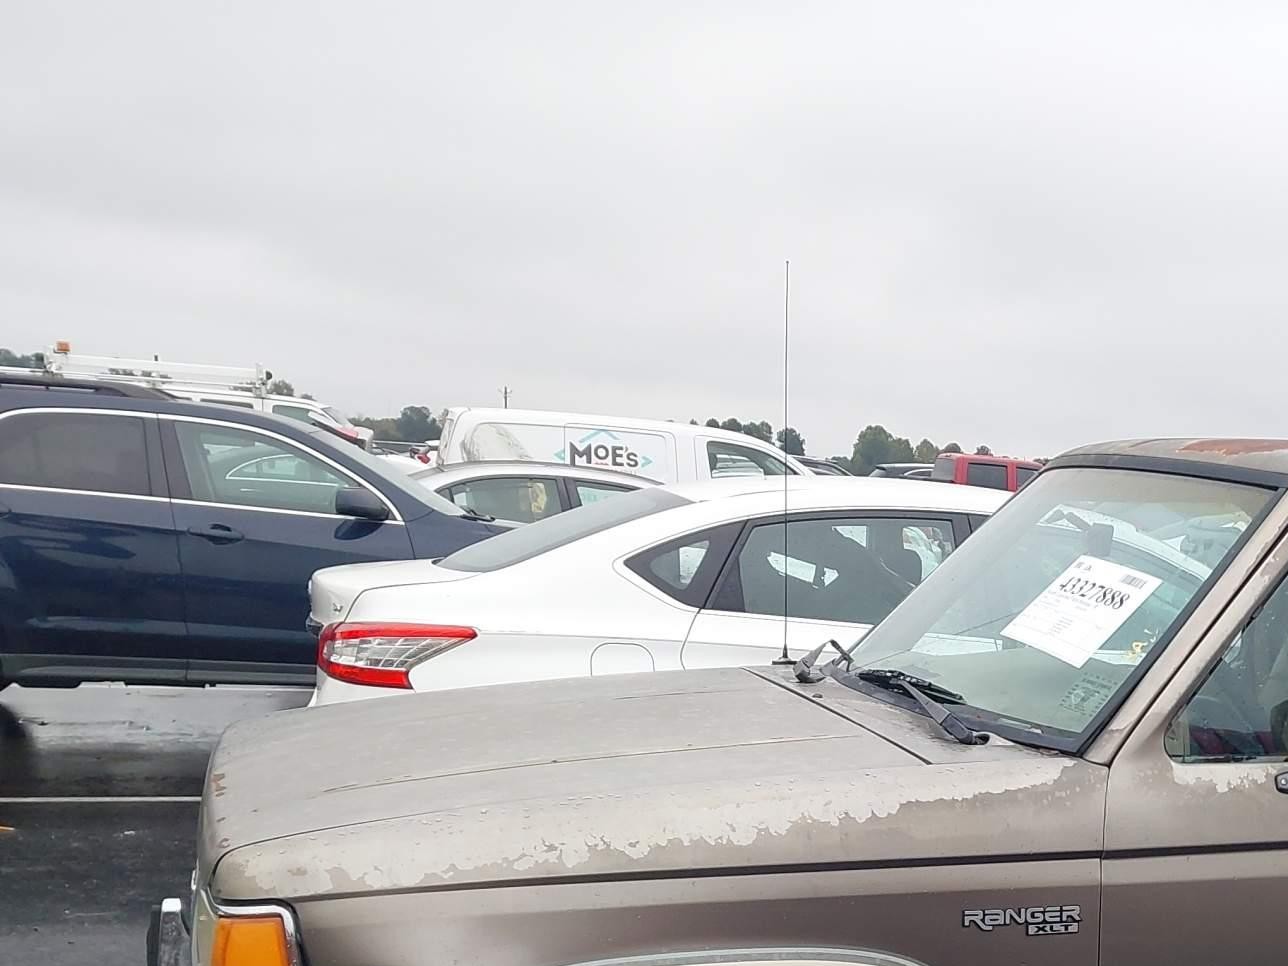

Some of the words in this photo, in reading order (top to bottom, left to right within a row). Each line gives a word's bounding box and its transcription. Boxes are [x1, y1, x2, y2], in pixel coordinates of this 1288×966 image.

[1058, 576, 1130, 610] 43327888
[962, 905, 1082, 931] RANGER
[1033, 924, 1073, 934] XLT
